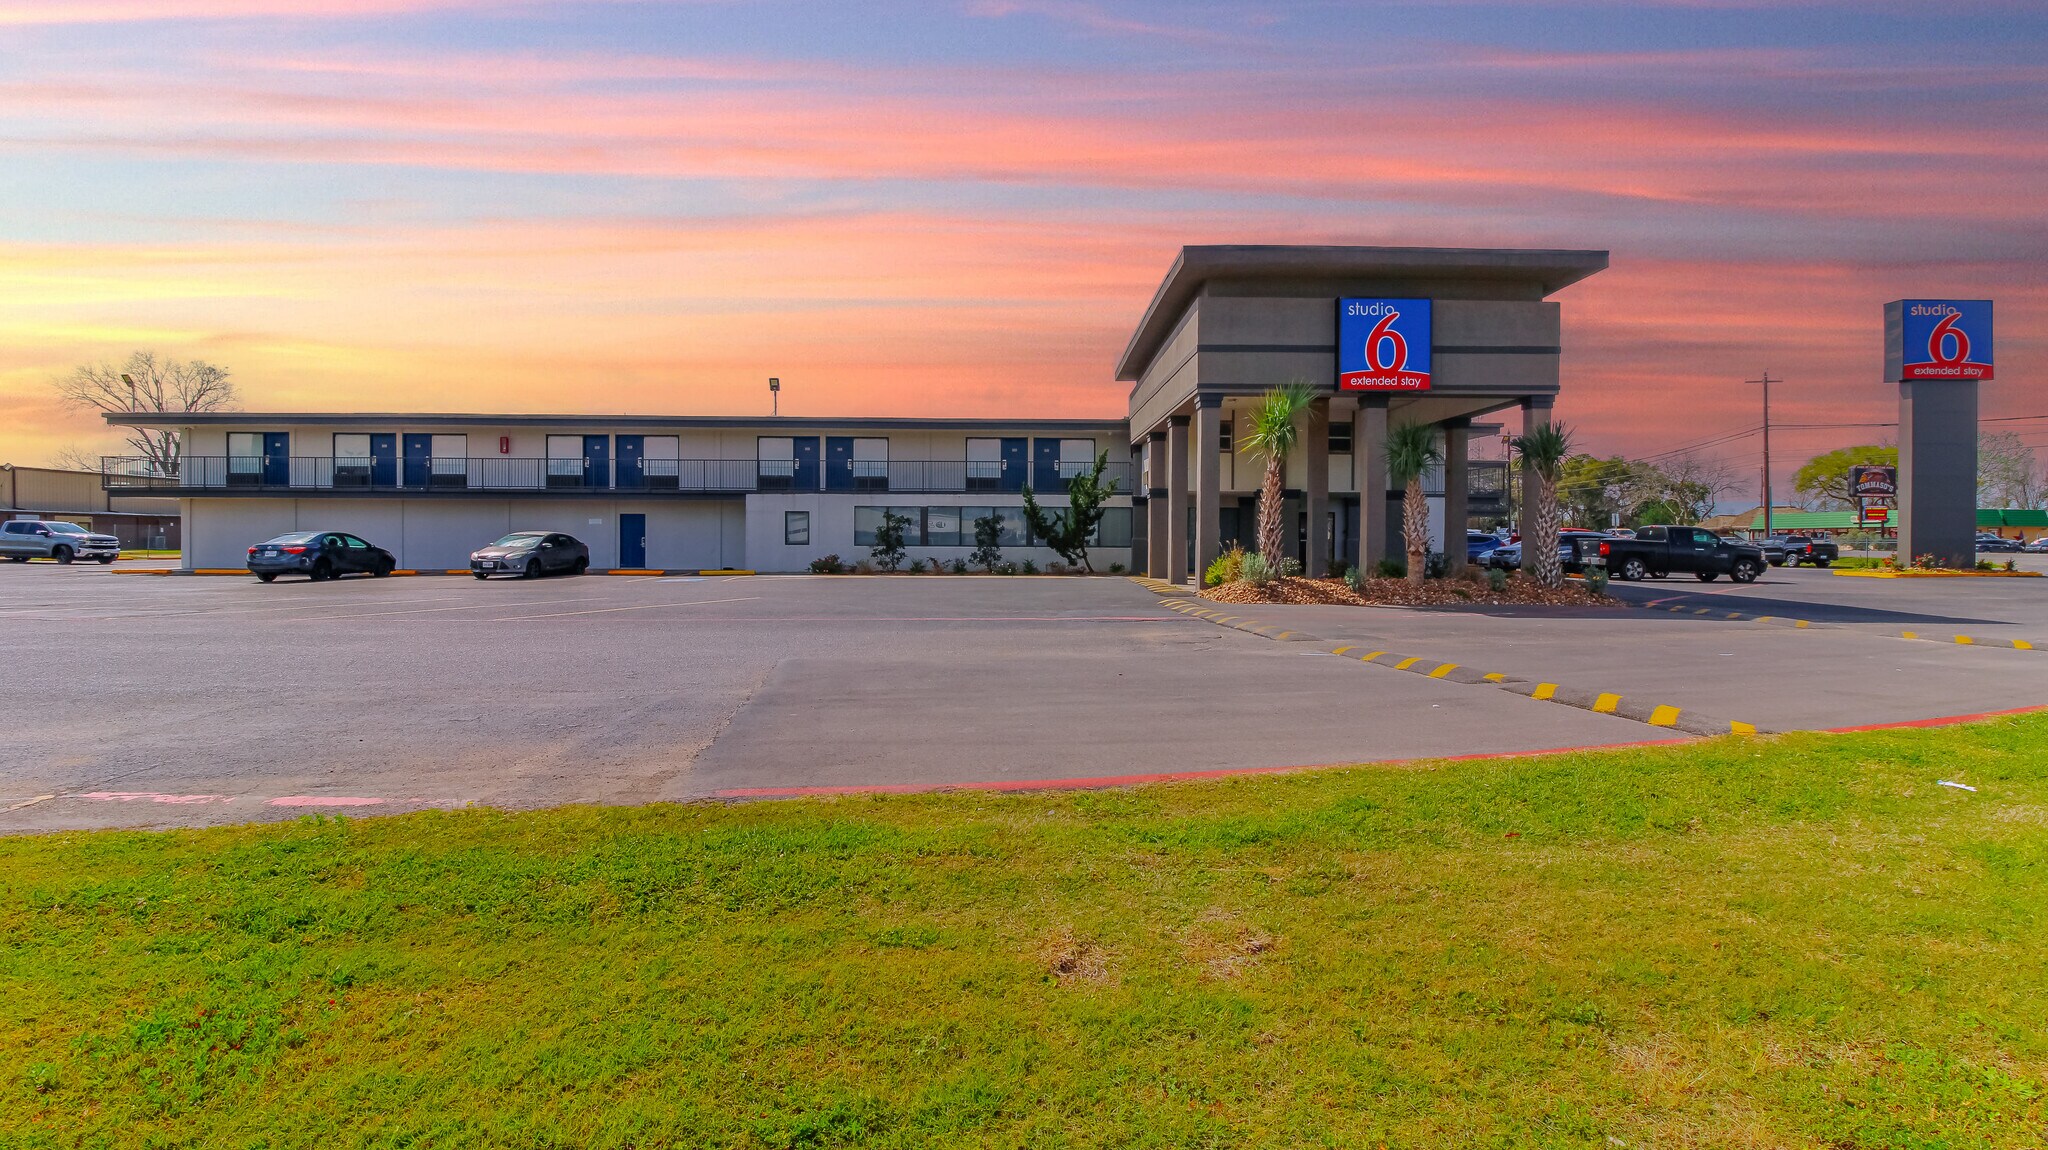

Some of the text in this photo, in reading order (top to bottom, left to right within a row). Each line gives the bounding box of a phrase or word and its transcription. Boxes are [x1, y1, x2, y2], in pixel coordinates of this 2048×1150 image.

[1348, 302, 1395, 316] studio
[1910, 304, 1957, 316] studio
[1365, 311, 1408, 372] 6
[1928, 312, 1971, 363] 6
[1914, 367, 1984, 377] extended stay
[1350, 376, 1422, 388] extended stay
[1856, 481, 1894, 492] TOMMASO'S
